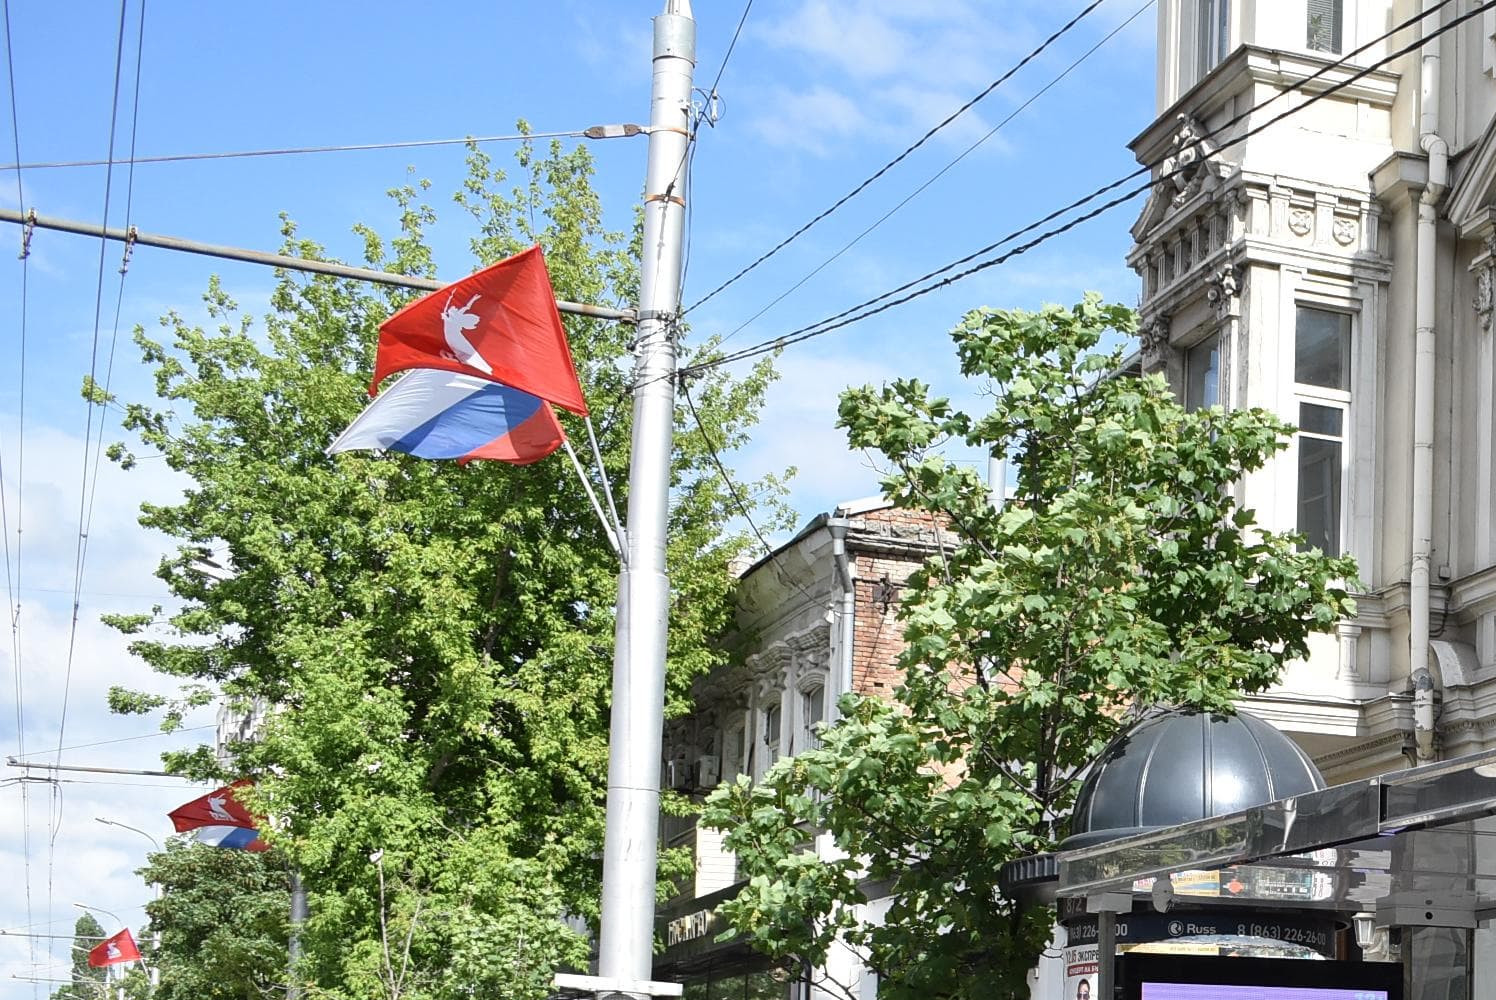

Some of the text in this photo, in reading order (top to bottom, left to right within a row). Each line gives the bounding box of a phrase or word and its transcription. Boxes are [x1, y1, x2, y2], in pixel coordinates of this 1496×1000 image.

[1186, 923, 1217, 934] Russ
[1237, 924, 1246, 936] 8
[1250, 923, 1281, 939] (863)
